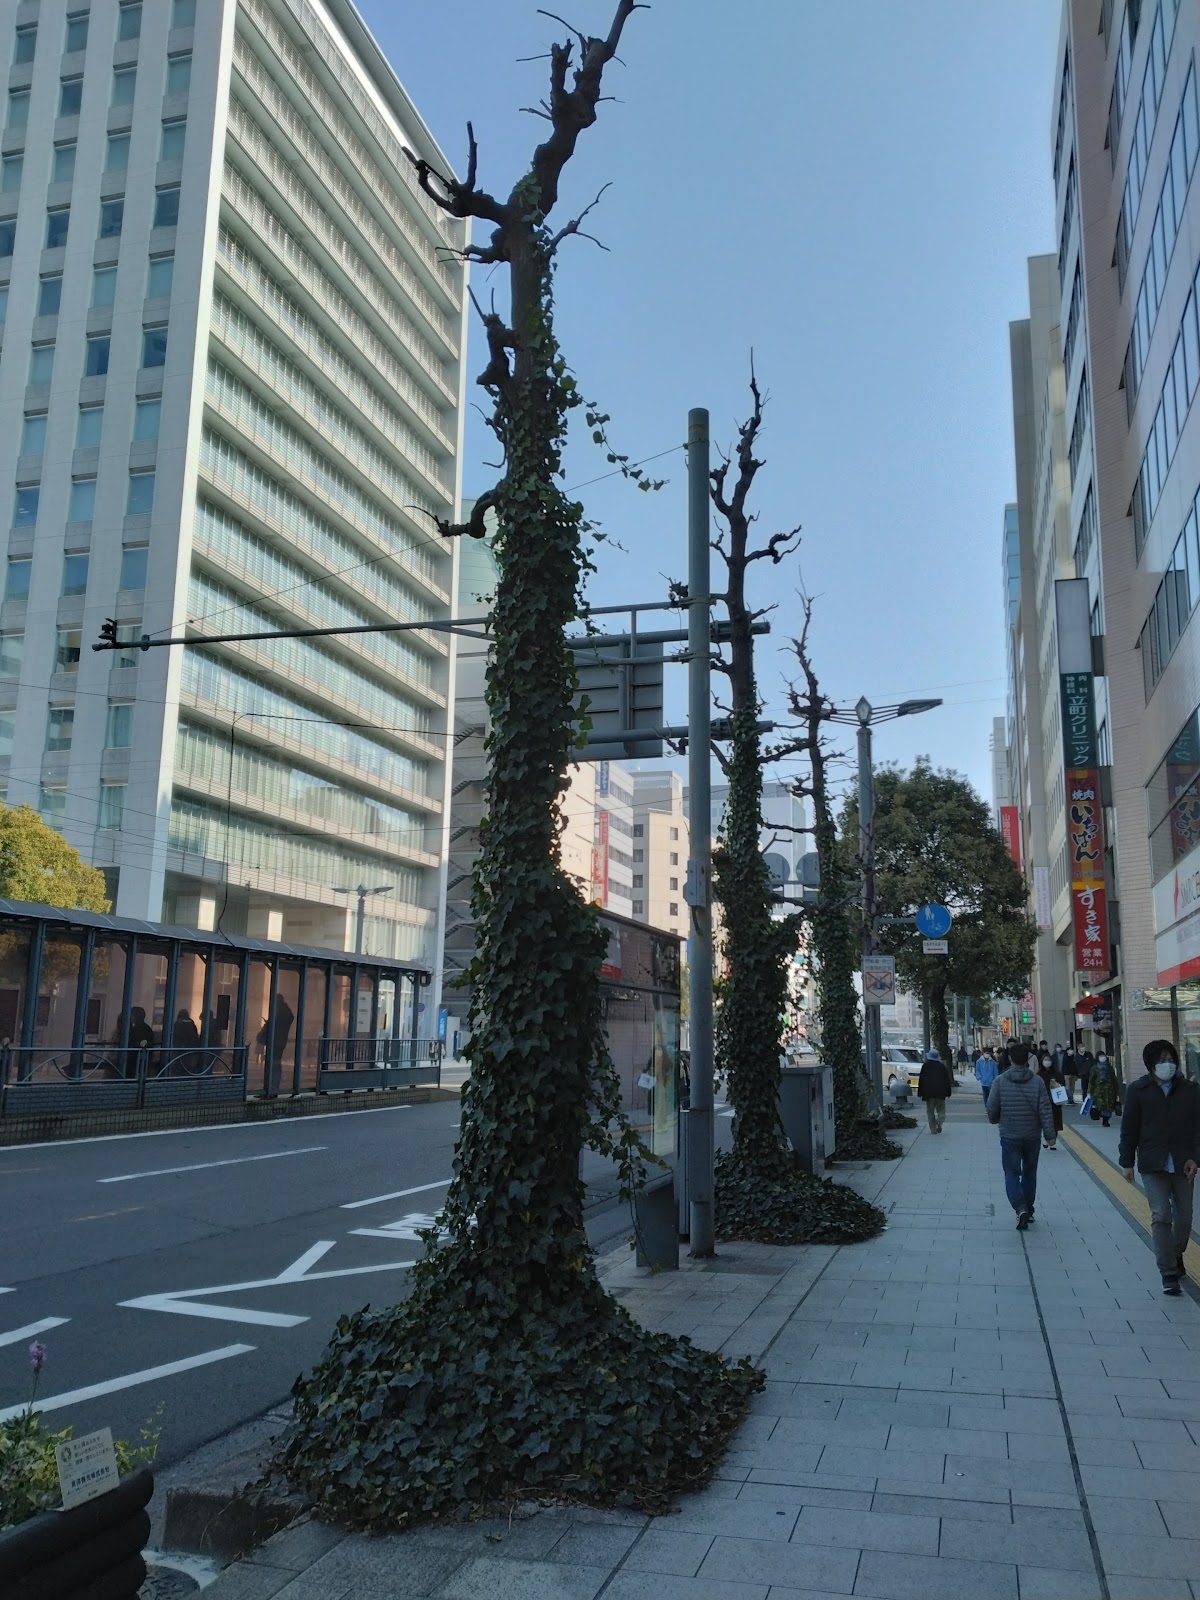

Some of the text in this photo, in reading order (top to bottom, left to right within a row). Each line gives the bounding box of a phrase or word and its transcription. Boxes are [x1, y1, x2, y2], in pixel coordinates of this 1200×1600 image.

[1068, 695, 1090, 766] 立町クリニック
[1072, 789, 1095, 801] 焼肉
[1070, 805, 1100, 863] いちばん
[1077, 884, 1102, 946] すき家
[1081, 948, 1103, 958] 営業
[1083, 958, 1103, 967] 24H
